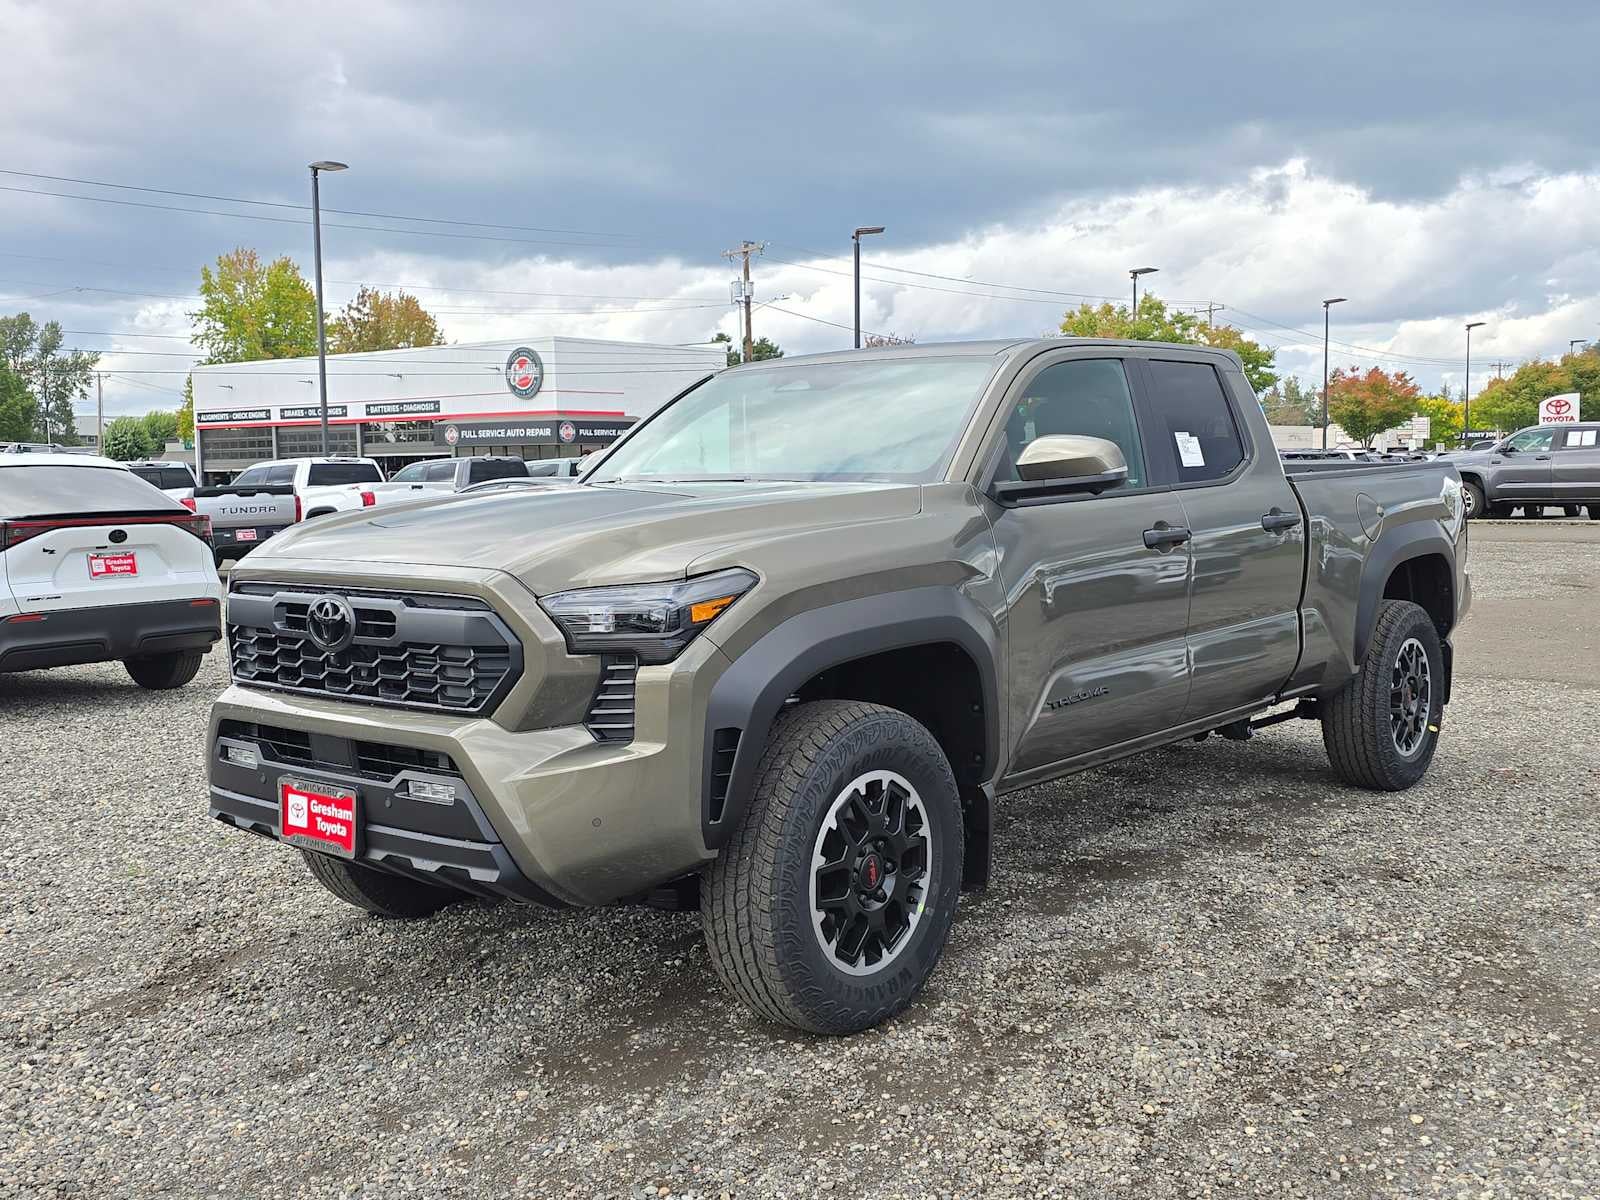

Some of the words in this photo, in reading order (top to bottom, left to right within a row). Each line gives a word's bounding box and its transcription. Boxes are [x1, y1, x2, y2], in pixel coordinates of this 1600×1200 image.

[284, 408, 304, 418] BRAKES
[308, 408, 317, 417] OIL
[317, 406, 343, 417] CNGES
[369, 404, 400, 414] BATTERIES
[403, 402, 434, 412] DIAGNOSIS
[200, 412, 229, 422] ALIGNMENTS
[232, 412, 249, 420] CHECK
[249, 410, 267, 419] ENGINE
[1542, 415, 1575, 423] TOYOTA
[460, 430, 477, 439] FULL
[478, 429, 505, 439] SERVICE
[506, 428, 525, 438] AUTO
[526, 427, 551, 437] REPAIR
[579, 428, 593, 436] FULL
[593, 428, 617, 437] SERVICE
[219, 505, 277, 515] TUNDRA
[105, 558, 133, 566] Gresham
[110, 565, 131, 573] Toyota
[310, 799, 353, 821] Gresham
[316, 817, 347, 837] Toyota
